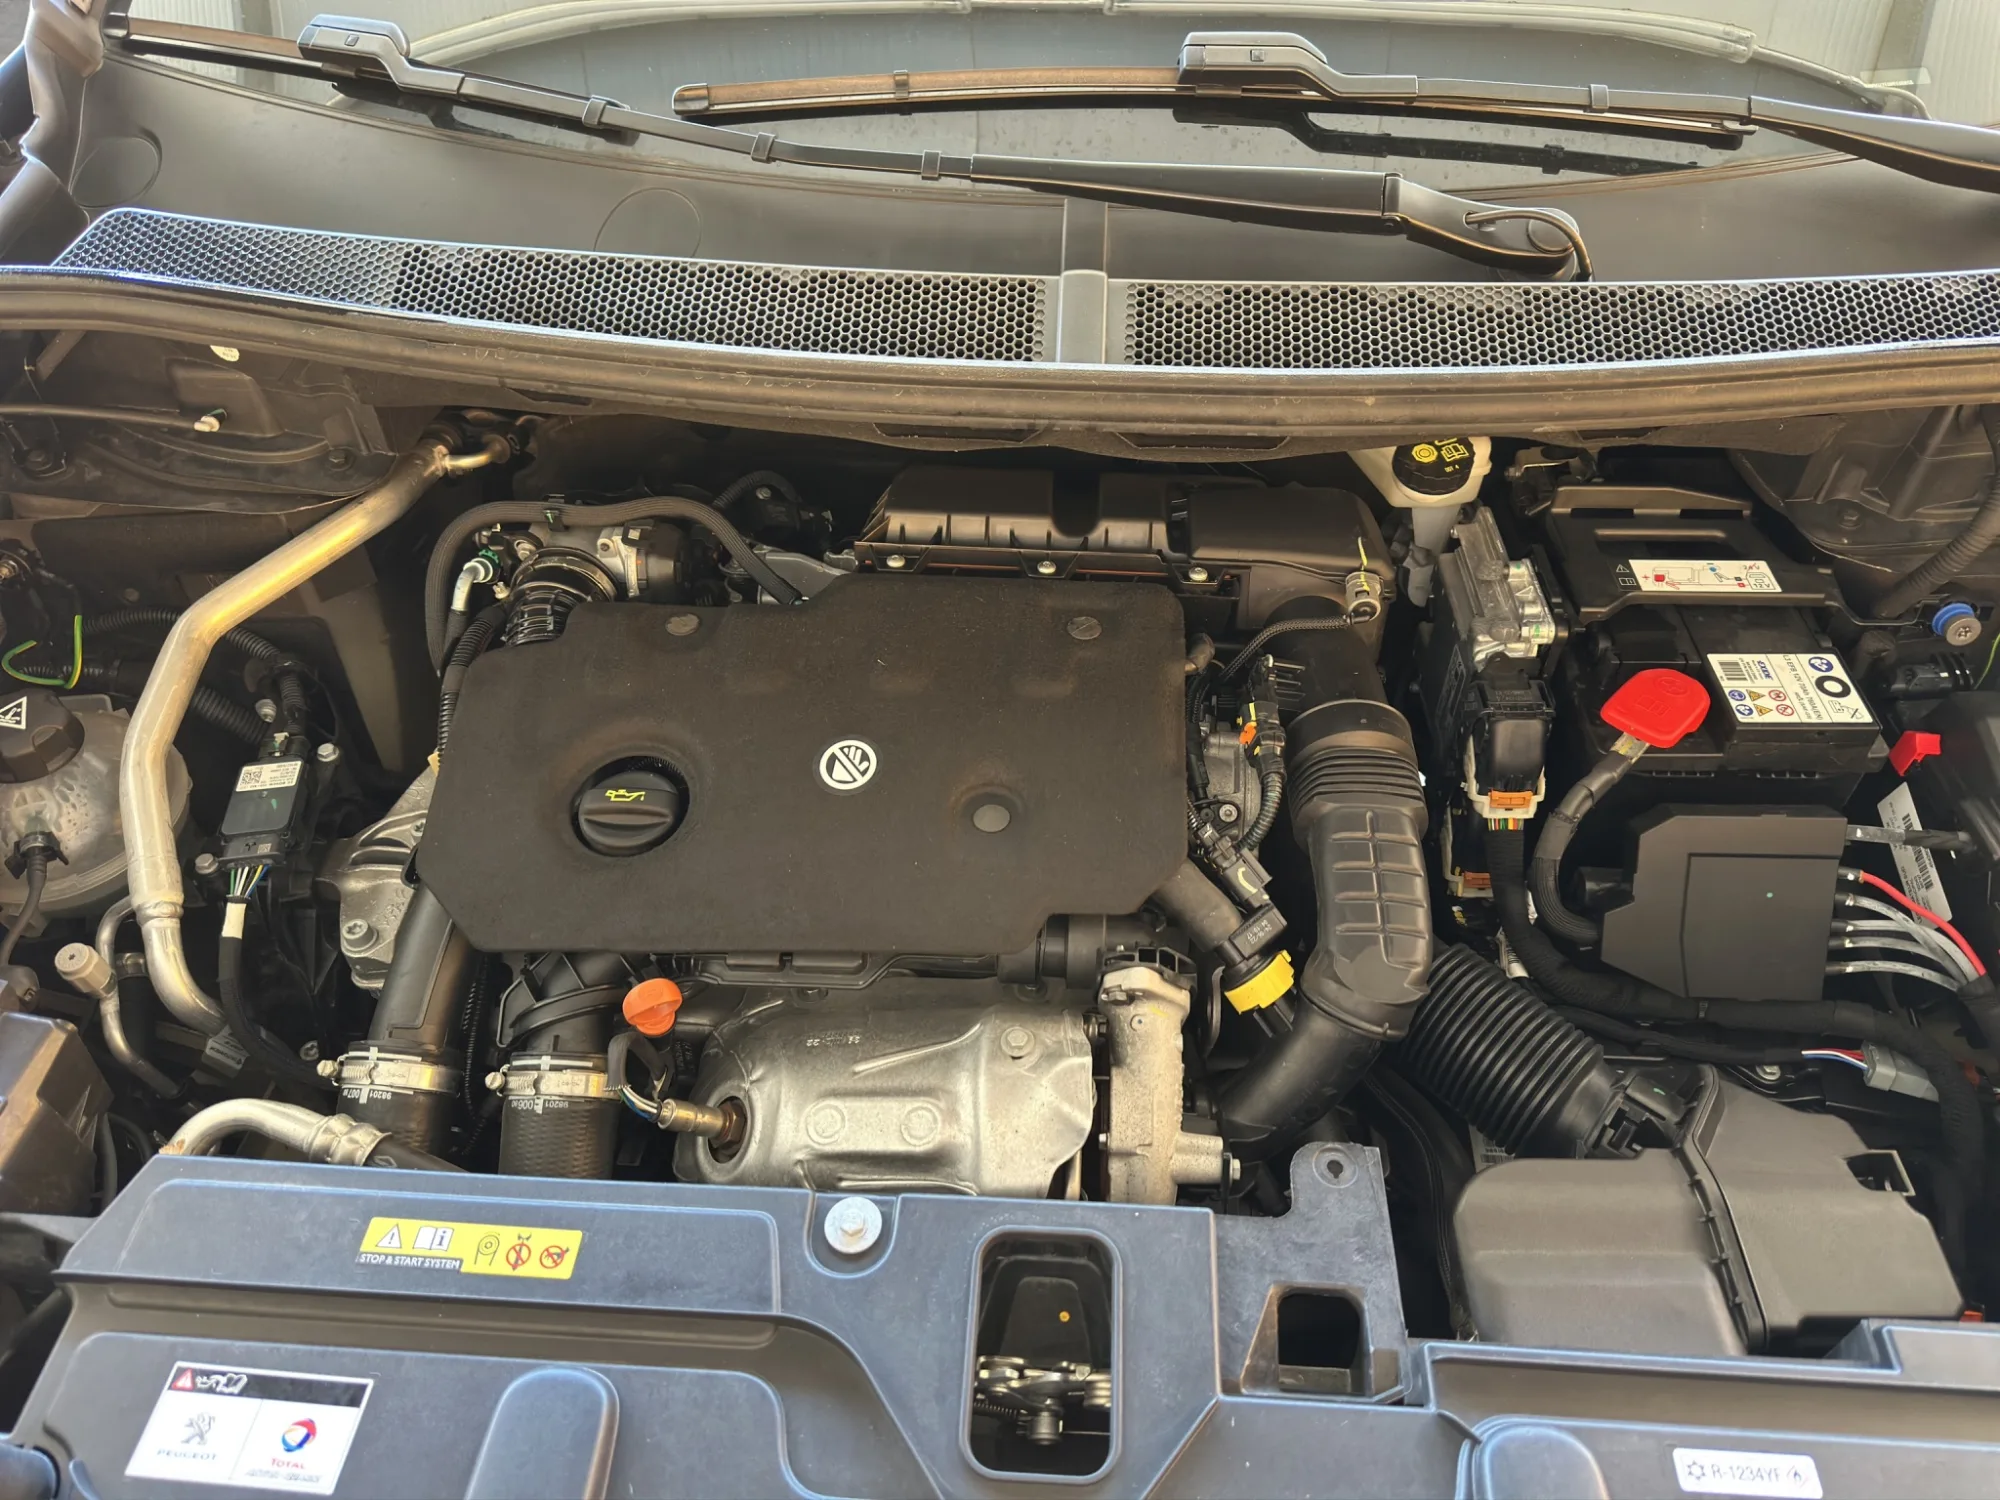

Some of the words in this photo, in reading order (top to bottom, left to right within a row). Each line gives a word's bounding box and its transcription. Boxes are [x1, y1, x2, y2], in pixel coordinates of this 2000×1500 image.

[369, 1090, 392, 1100] 98201
[545, 1101, 569, 1109] 98201
[360, 1253, 386, 1265] STOP
[386, 1255, 393, 1265] &
[394, 1256, 424, 1267] START
[424, 1258, 460, 1269] SYSTEM
[156, 1449, 217, 1461] PEUGEOT
[271, 1458, 305, 1469] TOTAL
